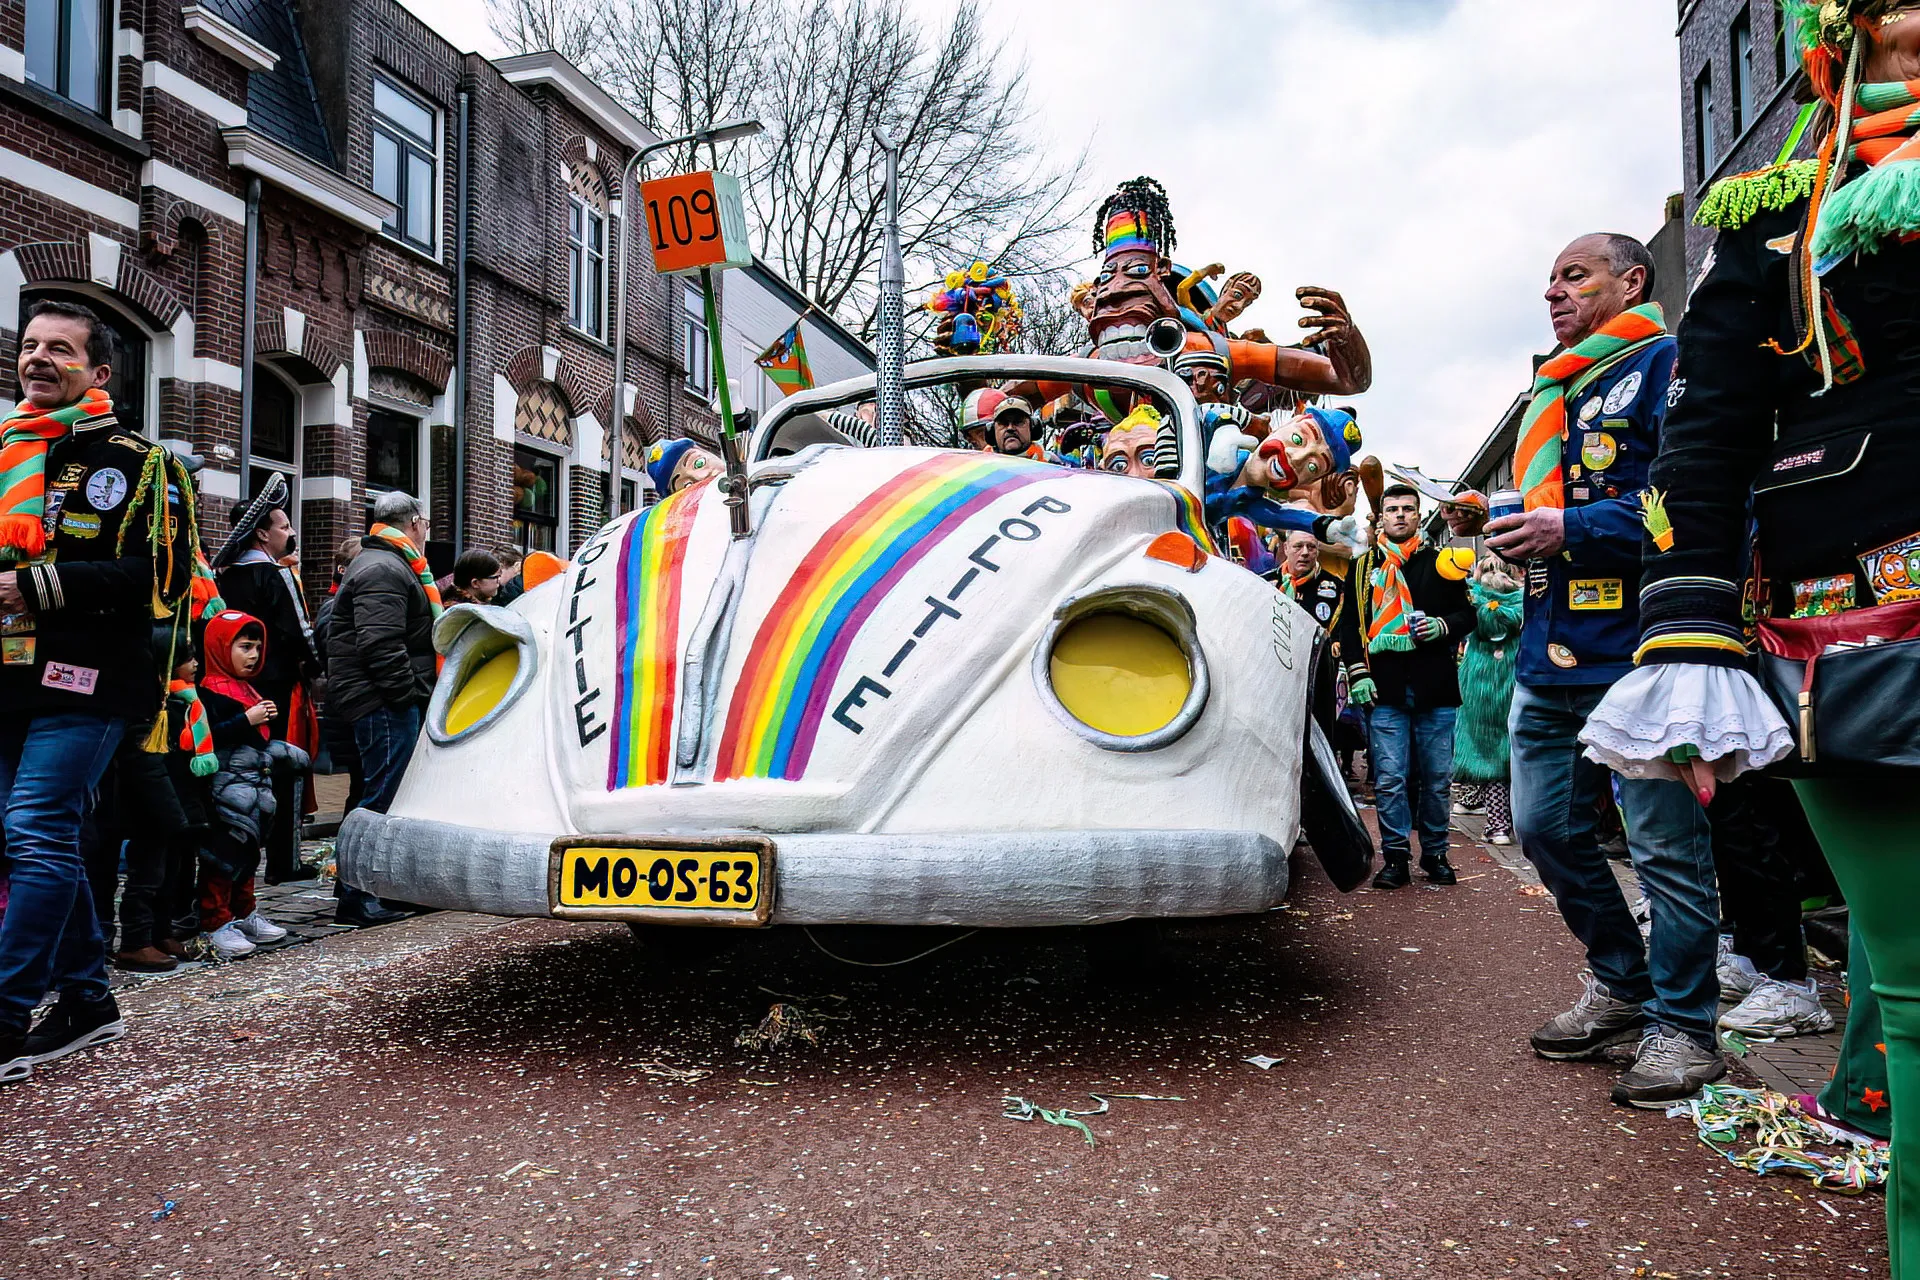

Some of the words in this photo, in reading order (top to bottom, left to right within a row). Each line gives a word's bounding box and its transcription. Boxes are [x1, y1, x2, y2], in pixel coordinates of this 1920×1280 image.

[648, 189, 719, 250] 109
[565, 524, 622, 748] POLITIE
[832, 496, 1072, 735] POLITIE
[573, 856, 753, 903] MO-OS-63
